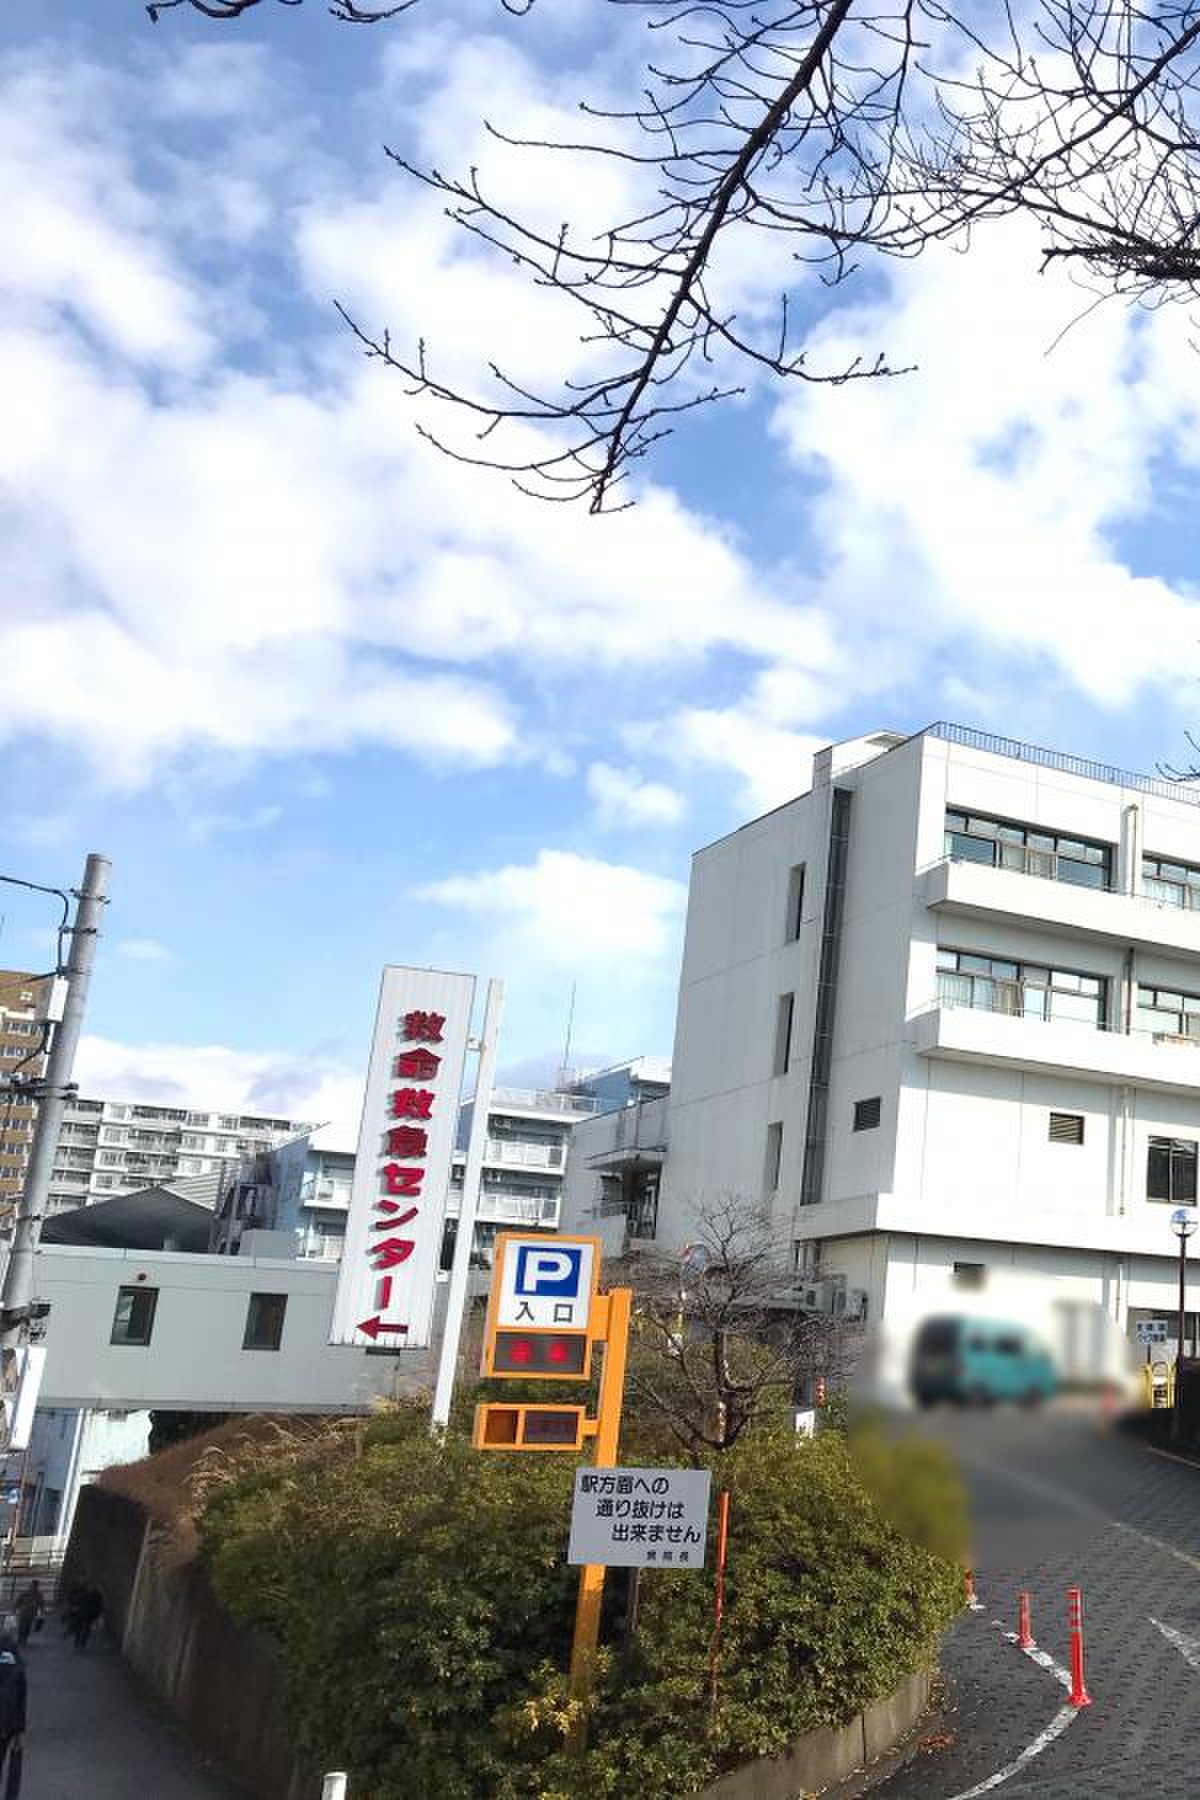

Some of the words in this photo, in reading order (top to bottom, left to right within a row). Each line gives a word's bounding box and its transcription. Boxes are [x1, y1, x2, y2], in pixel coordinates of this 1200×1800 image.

[367, 1010, 446, 1310] 救命救急センター
[523, 1252, 573, 1292] P
[515, 1301, 575, 1323] 入口
[580, 1475, 669, 1495] 駅方面への
[596, 1499, 684, 1519] 通り抜けは
[612, 1523, 700, 1543] 出来ません
